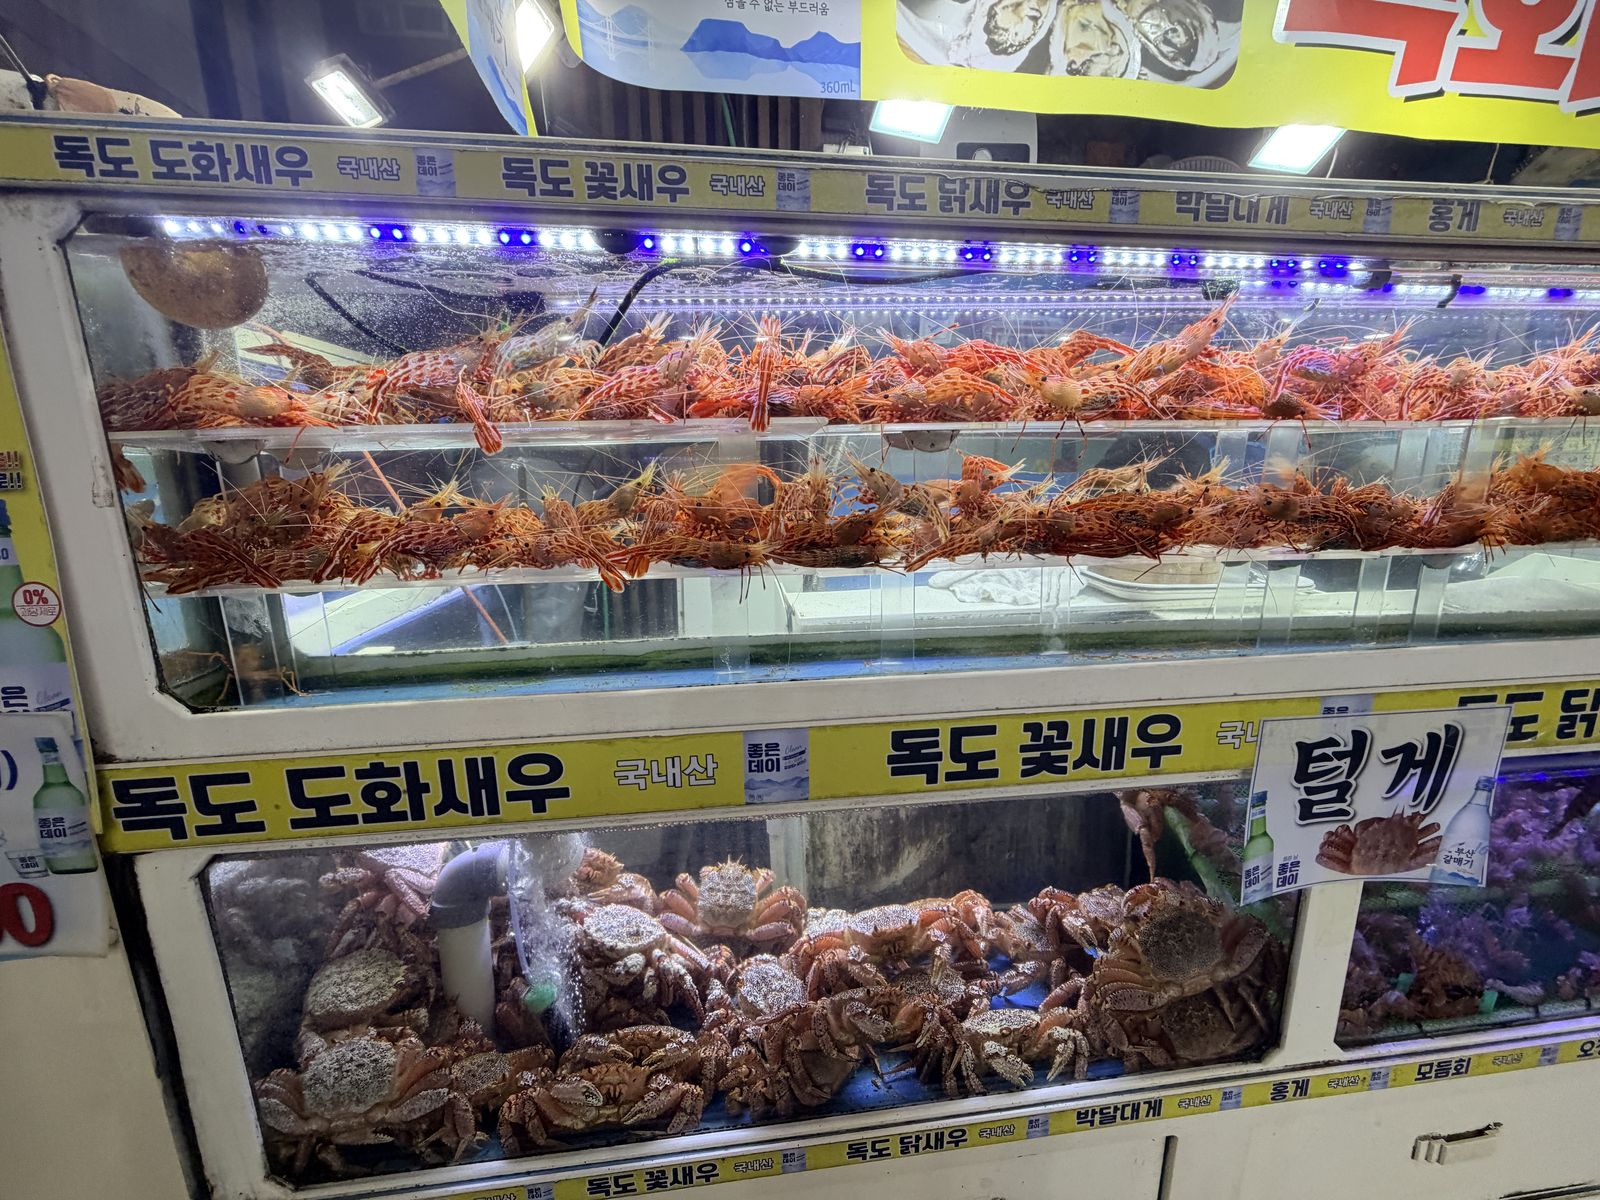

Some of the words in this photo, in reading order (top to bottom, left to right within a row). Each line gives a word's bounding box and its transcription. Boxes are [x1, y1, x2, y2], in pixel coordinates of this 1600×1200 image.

[787, 1, 830, 16] 부드러움
[820, 80, 856, 94] 360mL
[53, 135, 140, 178] 독도
[149, 139, 313, 187] 도화새우
[336, 155, 401, 181] 국내산
[502, 156, 575, 198] 독도
[584, 160, 690, 203] 꽃새우
[709, 173, 766, 197] 국내산
[865, 174, 928, 211] 독도
[938, 177, 1031, 216] 닭새우
[1045, 190, 1096, 210] 국내산
[1309, 199, 1354, 220] 국내산
[1503, 207, 1545, 227] 국내산
[23, 589, 49, 605] 0%
[747, 742, 781, 758] 좋은
[886, 724, 1000, 785] 독도
[1018, 713, 1184, 778] 꽃새우
[748, 757, 781, 774] 데이
[1295, 722, 1462, 823] 털게
[112, 772, 267, 841] 독도
[285, 752, 571, 831] 도화새우
[613, 753, 719, 791] 국내산
[38, 816, 66, 828] 좋은
[40, 827, 68, 839] 데이
[1443, 855, 1474, 869] 갈매기
[1454, 847, 1476, 859] 부산
[1276, 873, 1299, 888] 데이
[1414, 1057, 1472, 1082] 모듬회
[1270, 1078, 1311, 1101] 홍게
[1327, 1075, 1361, 1089] 국내산
[1076, 1098, 1163, 1127] 박달대게
[1178, 1095, 1212, 1109] 국내산
[846, 1138, 892, 1161] 독도
[899, 1128, 968, 1155] 닭새우
[979, 1124, 1015, 1139] 국내산
[587, 1173, 637, 1197] 독도
[644, 1162, 719, 1191] 꽃새우
[734, 1158, 774, 1173] 국내산
